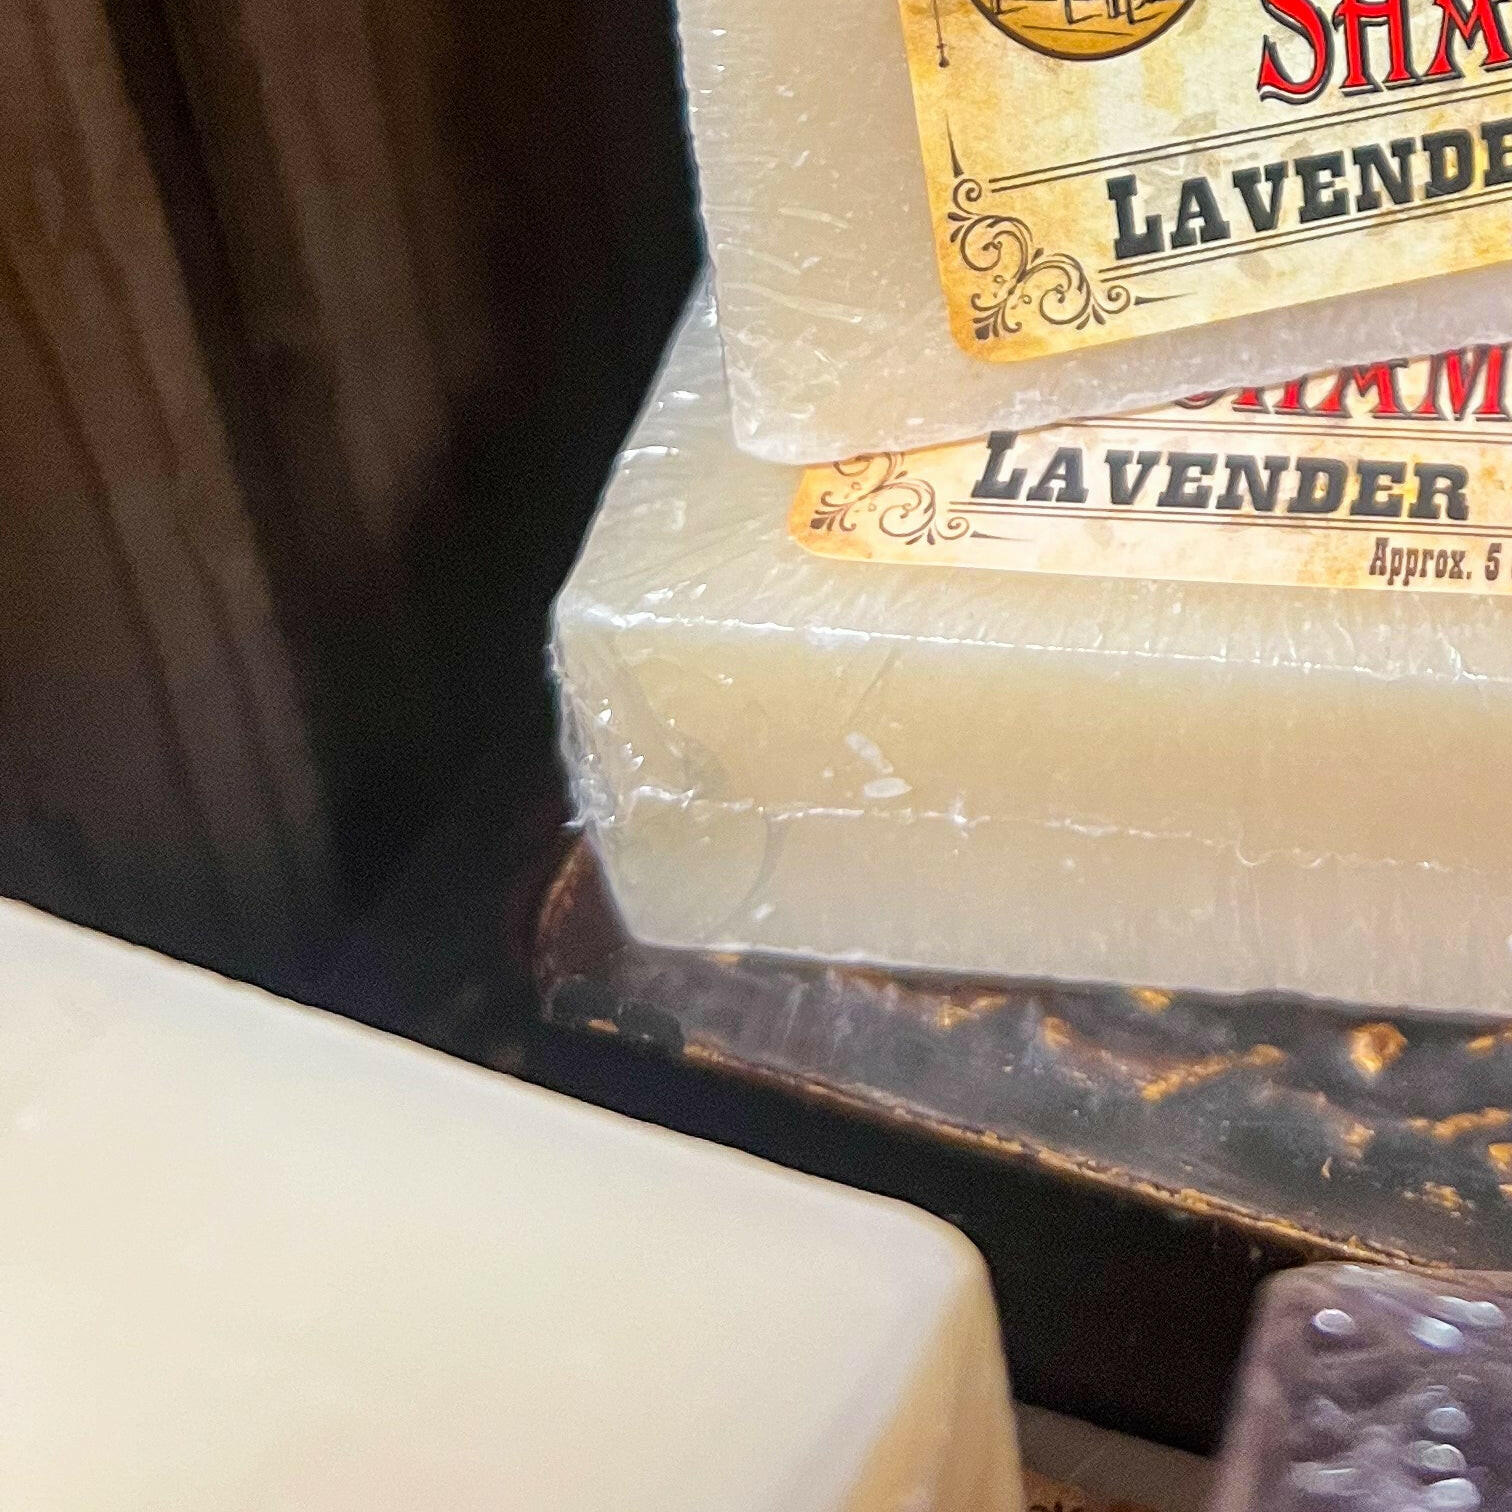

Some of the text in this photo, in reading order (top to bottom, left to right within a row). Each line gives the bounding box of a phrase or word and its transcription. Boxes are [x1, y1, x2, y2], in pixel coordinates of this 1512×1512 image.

[967, 430, 1470, 522] LAVENDER
[1368, 537, 1472, 586] Approx.
[1484, 542, 1502, 581] 5
